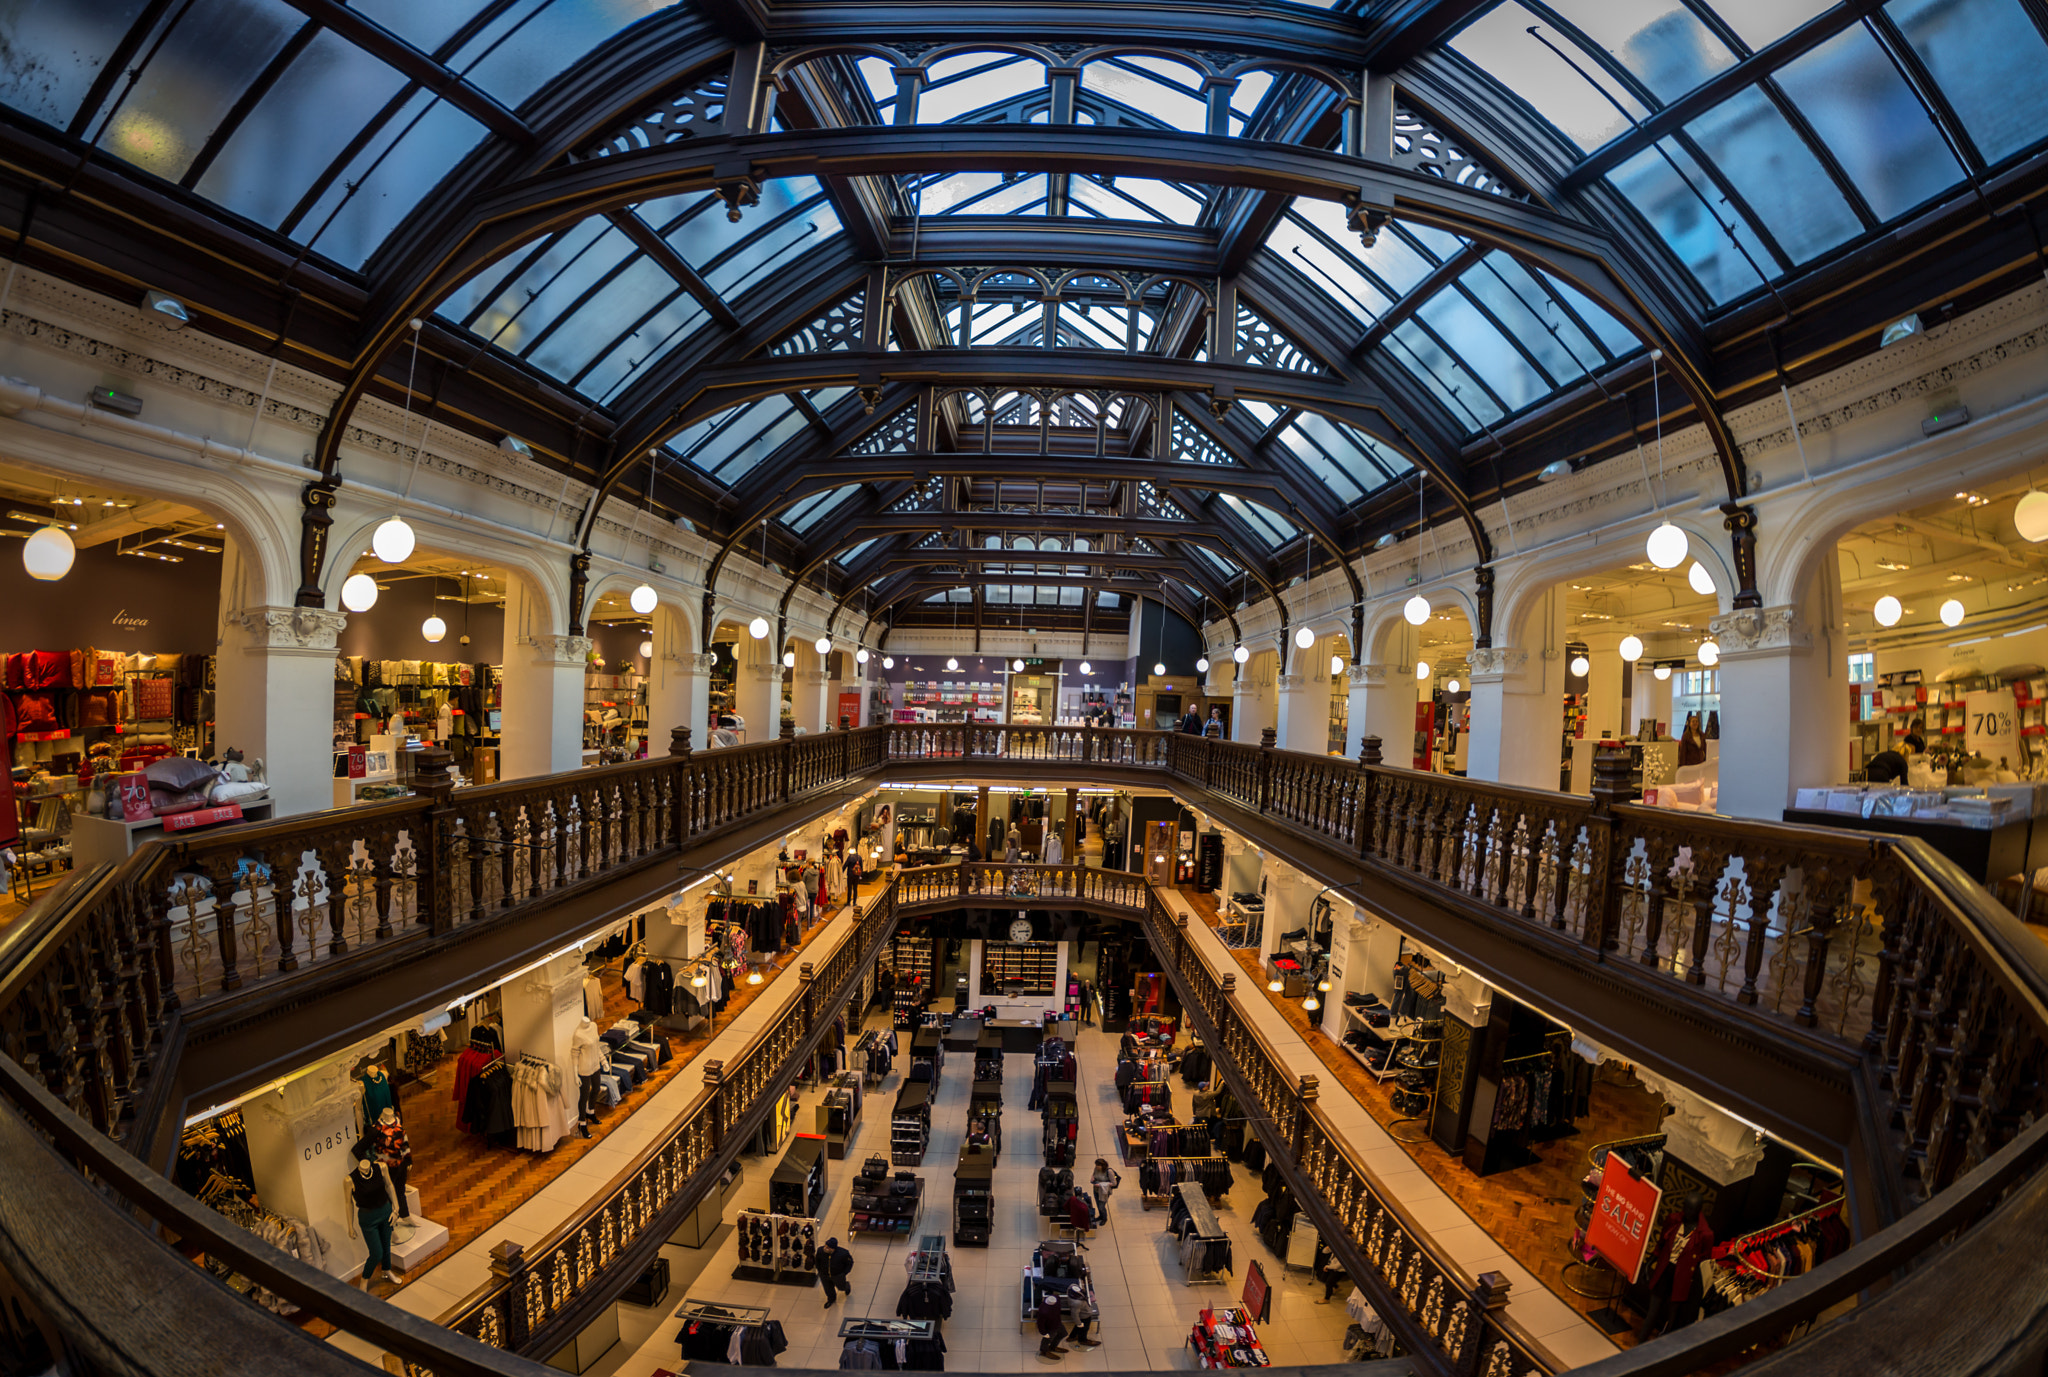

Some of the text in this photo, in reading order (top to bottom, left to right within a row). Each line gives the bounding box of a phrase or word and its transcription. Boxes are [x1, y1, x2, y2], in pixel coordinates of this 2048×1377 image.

[112, 609, 149, 626] linea
[351, 753, 364, 765] 70
[124, 785, 146, 803] 70
[134, 801, 148, 810] OFF
[174, 816, 196, 828] SALE
[213, 810, 235, 820] SALE
[304, 1124, 351, 1161] coast
[1605, 1185, 1645, 1221] THE BIG BRAND
[1601, 1196, 1642, 1239] SALE
[1605, 1222, 1629, 1245] NOW ON
